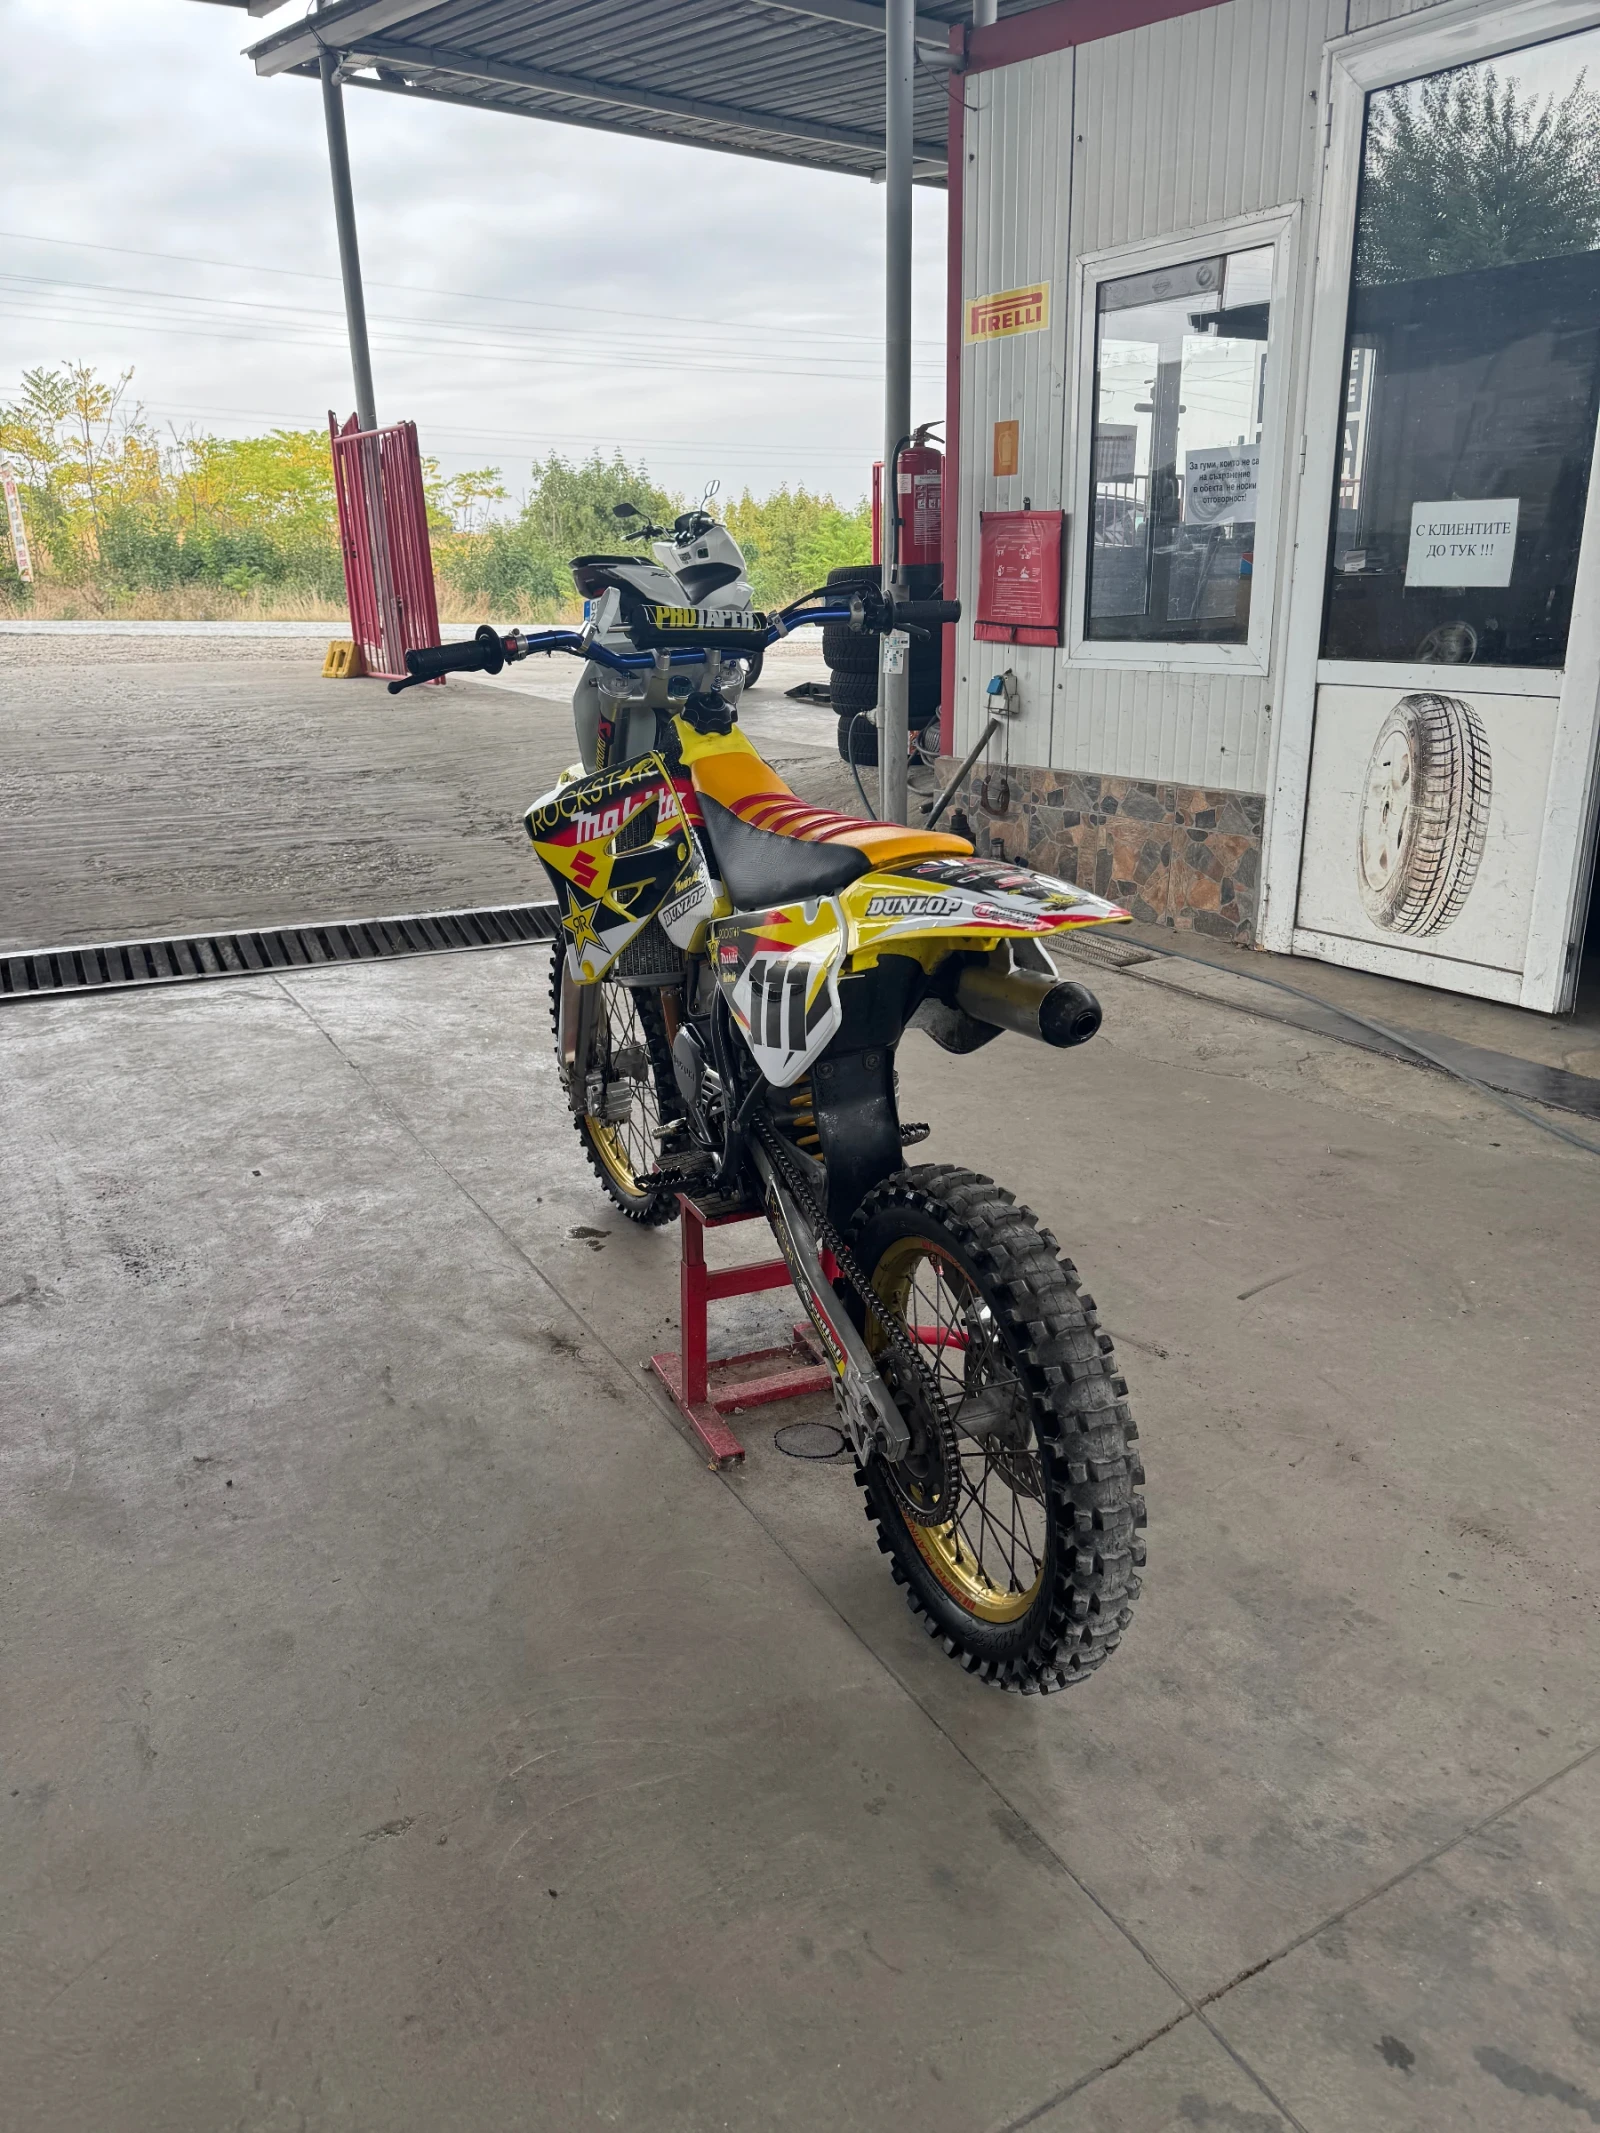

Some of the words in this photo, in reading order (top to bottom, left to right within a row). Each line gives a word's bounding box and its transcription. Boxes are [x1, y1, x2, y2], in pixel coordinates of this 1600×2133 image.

[971, 292, 1043, 335] PIRELLI
[1189, 461, 1198, 470] За
[1219, 459, 1240, 468] които
[1241, 458, 1251, 466] не
[1199, 473, 1207, 481] на
[1226, 483, 1235, 491] не
[1202, 493, 1247, 504] отговорност!
[1415, 524, 1426, 537] С
[1428, 522, 1511, 536] КЛИЕНТИТЕ
[1426, 544, 1446, 558] ДО
[1449, 544, 1477, 556] ТУК
[663, 885, 707, 928] DUNLOP
[865, 896, 963, 917] DUNLOP
[749, 960, 812, 1051] 111
